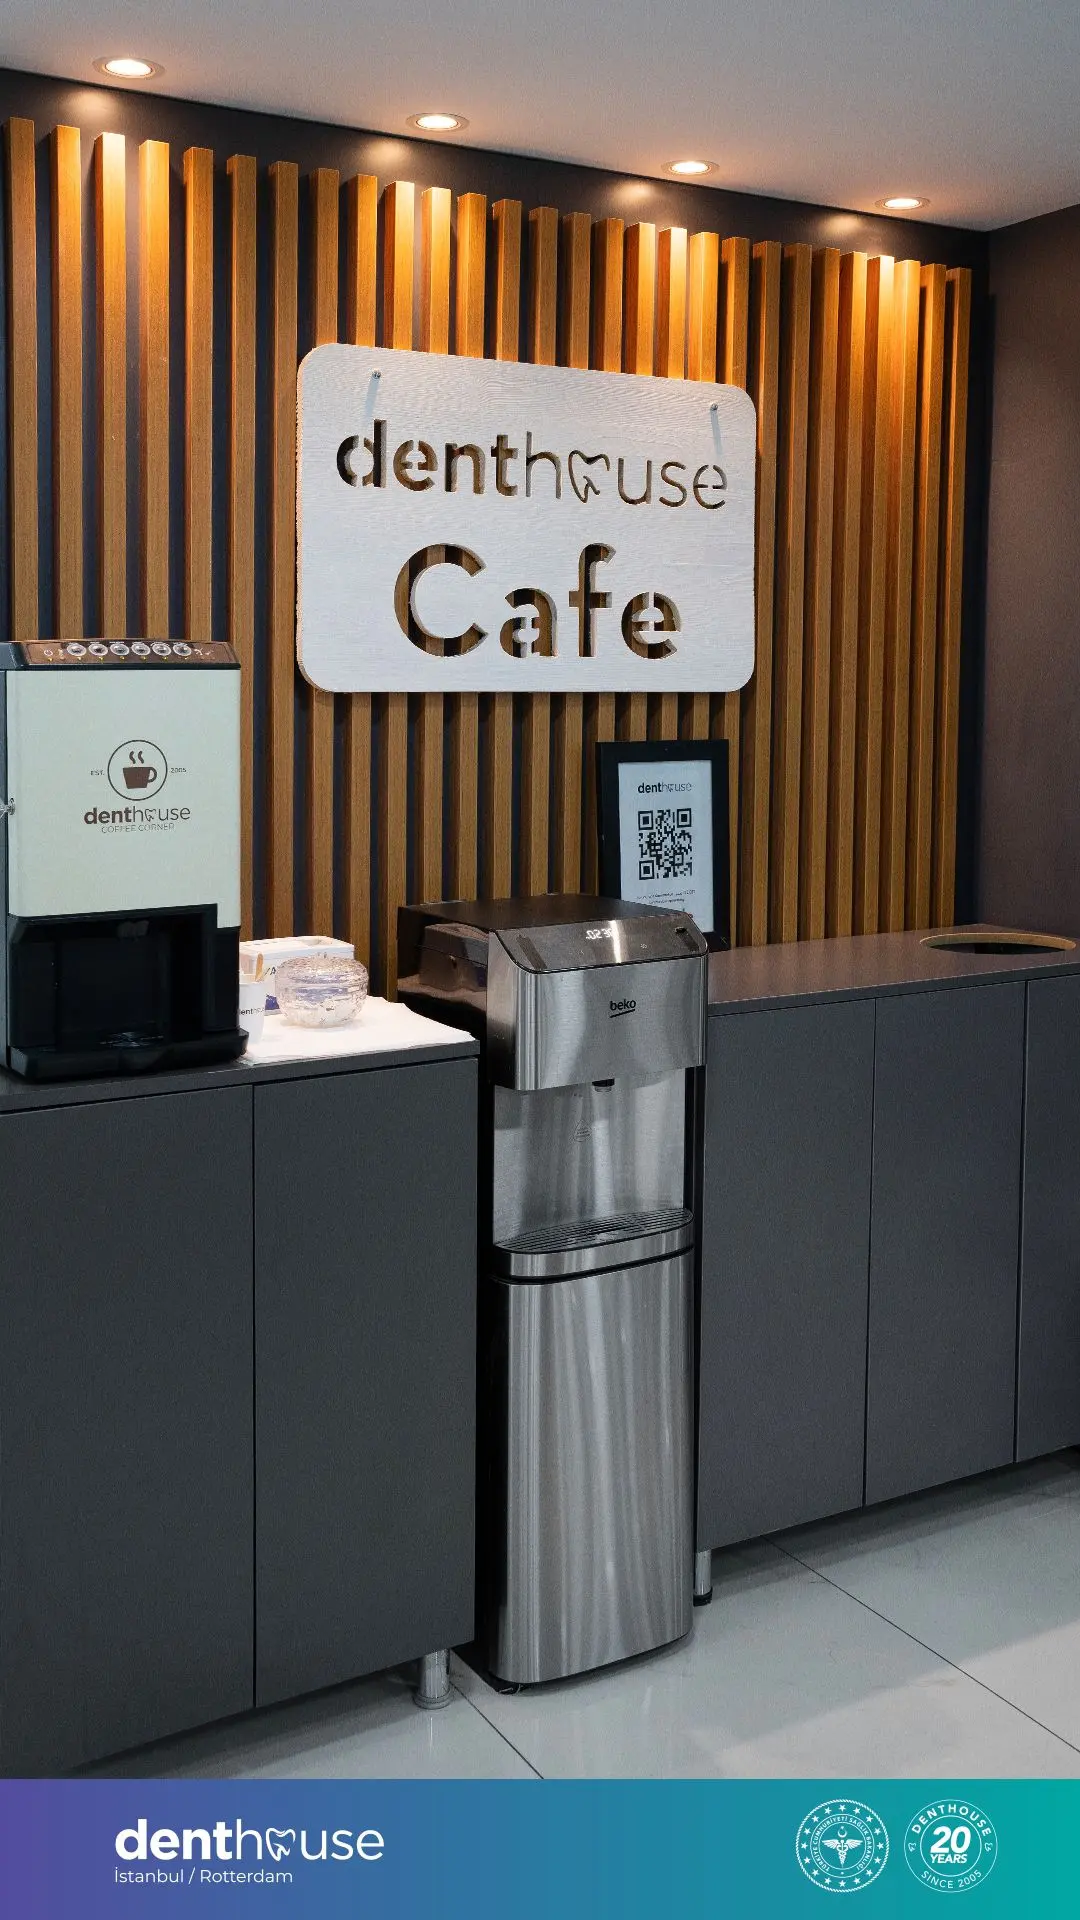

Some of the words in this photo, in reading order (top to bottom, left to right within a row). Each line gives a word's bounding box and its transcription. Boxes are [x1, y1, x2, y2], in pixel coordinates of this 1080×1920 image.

[336, 419, 728, 510] denthouse
[393, 542, 682, 660] Cafe
[637, 781, 692, 794] denthouse
[83, 805, 191, 825] denthouse
[101, 824, 137, 834] COFFEE
[138, 822, 175, 832] CORNER
[609, 999, 637, 1011] beko
